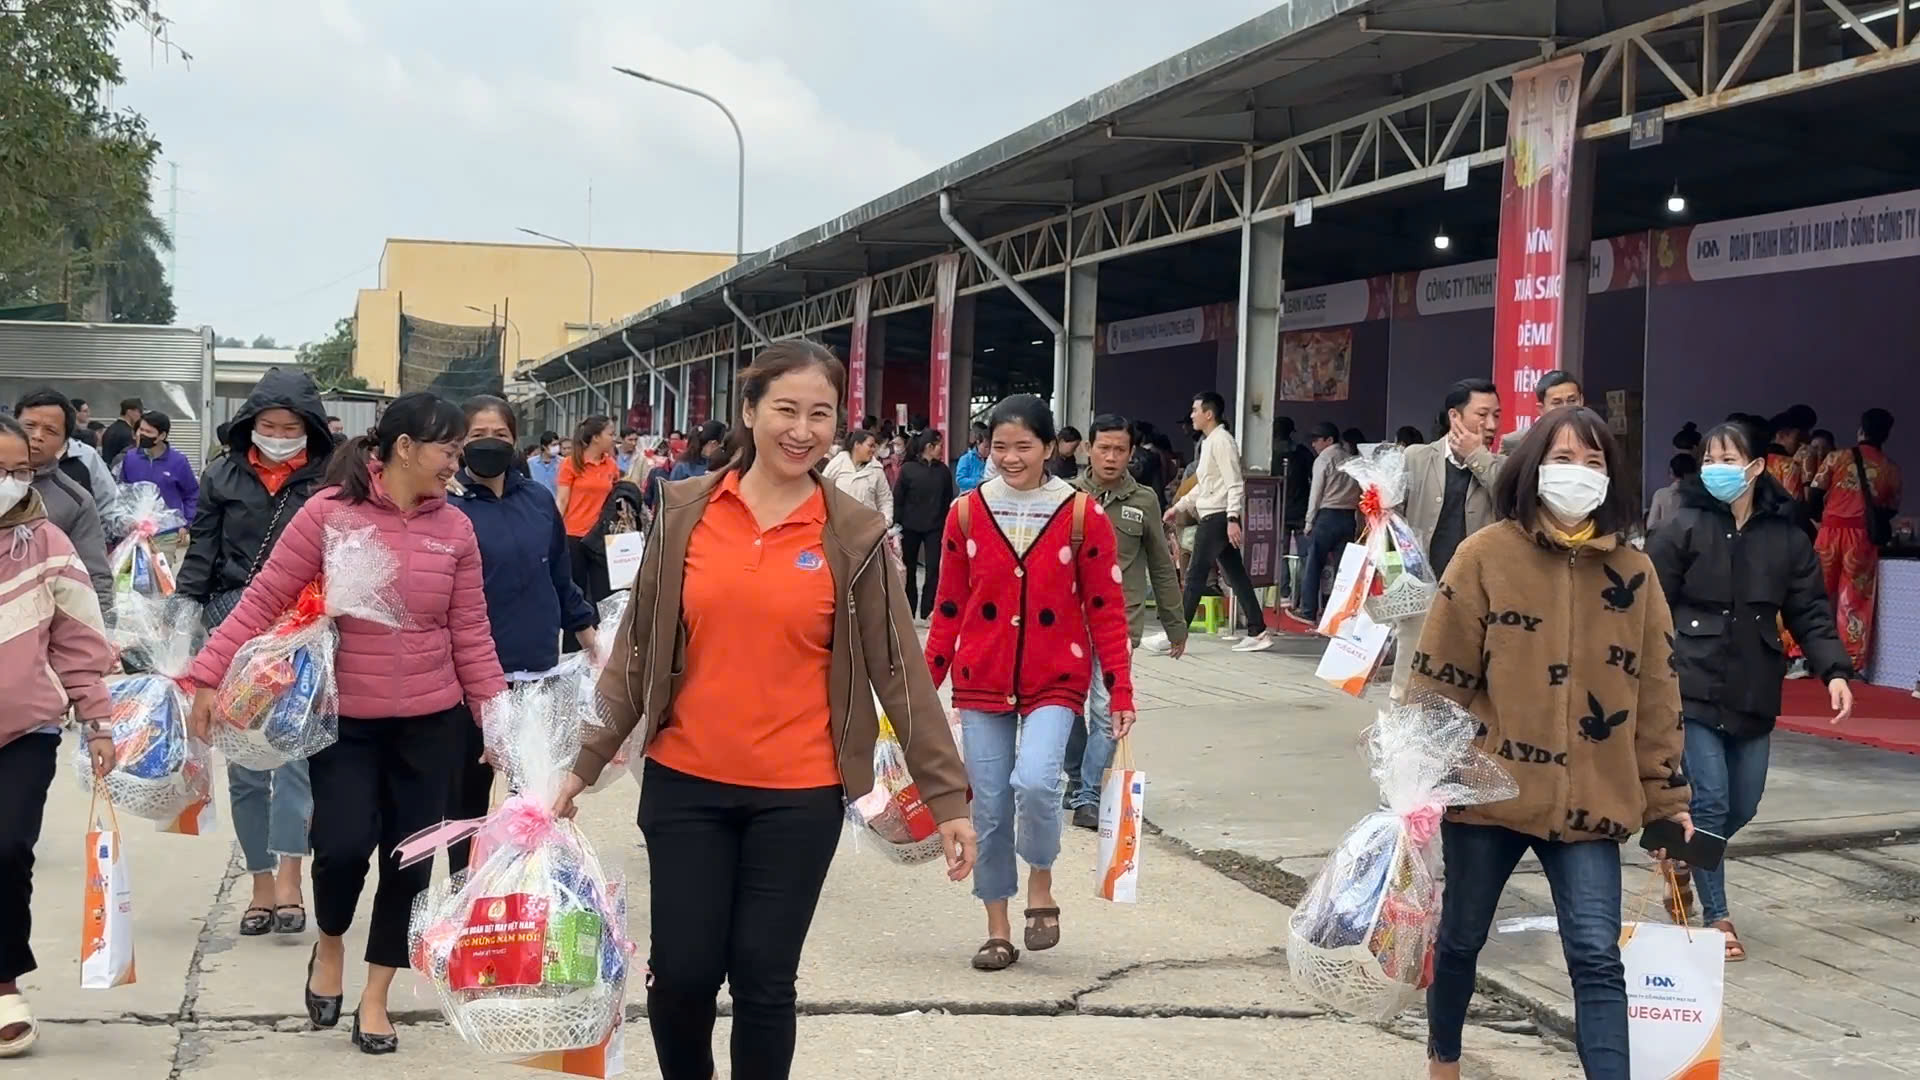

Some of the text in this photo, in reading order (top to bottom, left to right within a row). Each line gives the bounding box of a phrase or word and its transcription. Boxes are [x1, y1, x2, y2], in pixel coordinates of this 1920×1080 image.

[1752, 229, 1778, 259] THANH
[1814, 222, 1832, 252] BAN
[1877, 206, 1903, 243] CÔNG
[1904, 208, 1917, 239] TY
[1425, 275, 1493, 302] CÔNG TY TNHH
[1411, 650, 1488, 690] PLAY
[1605, 645, 1640, 679] PL
[519, 920, 536, 930] NAM
[1628, 1005, 1703, 1023] UEGATEX
